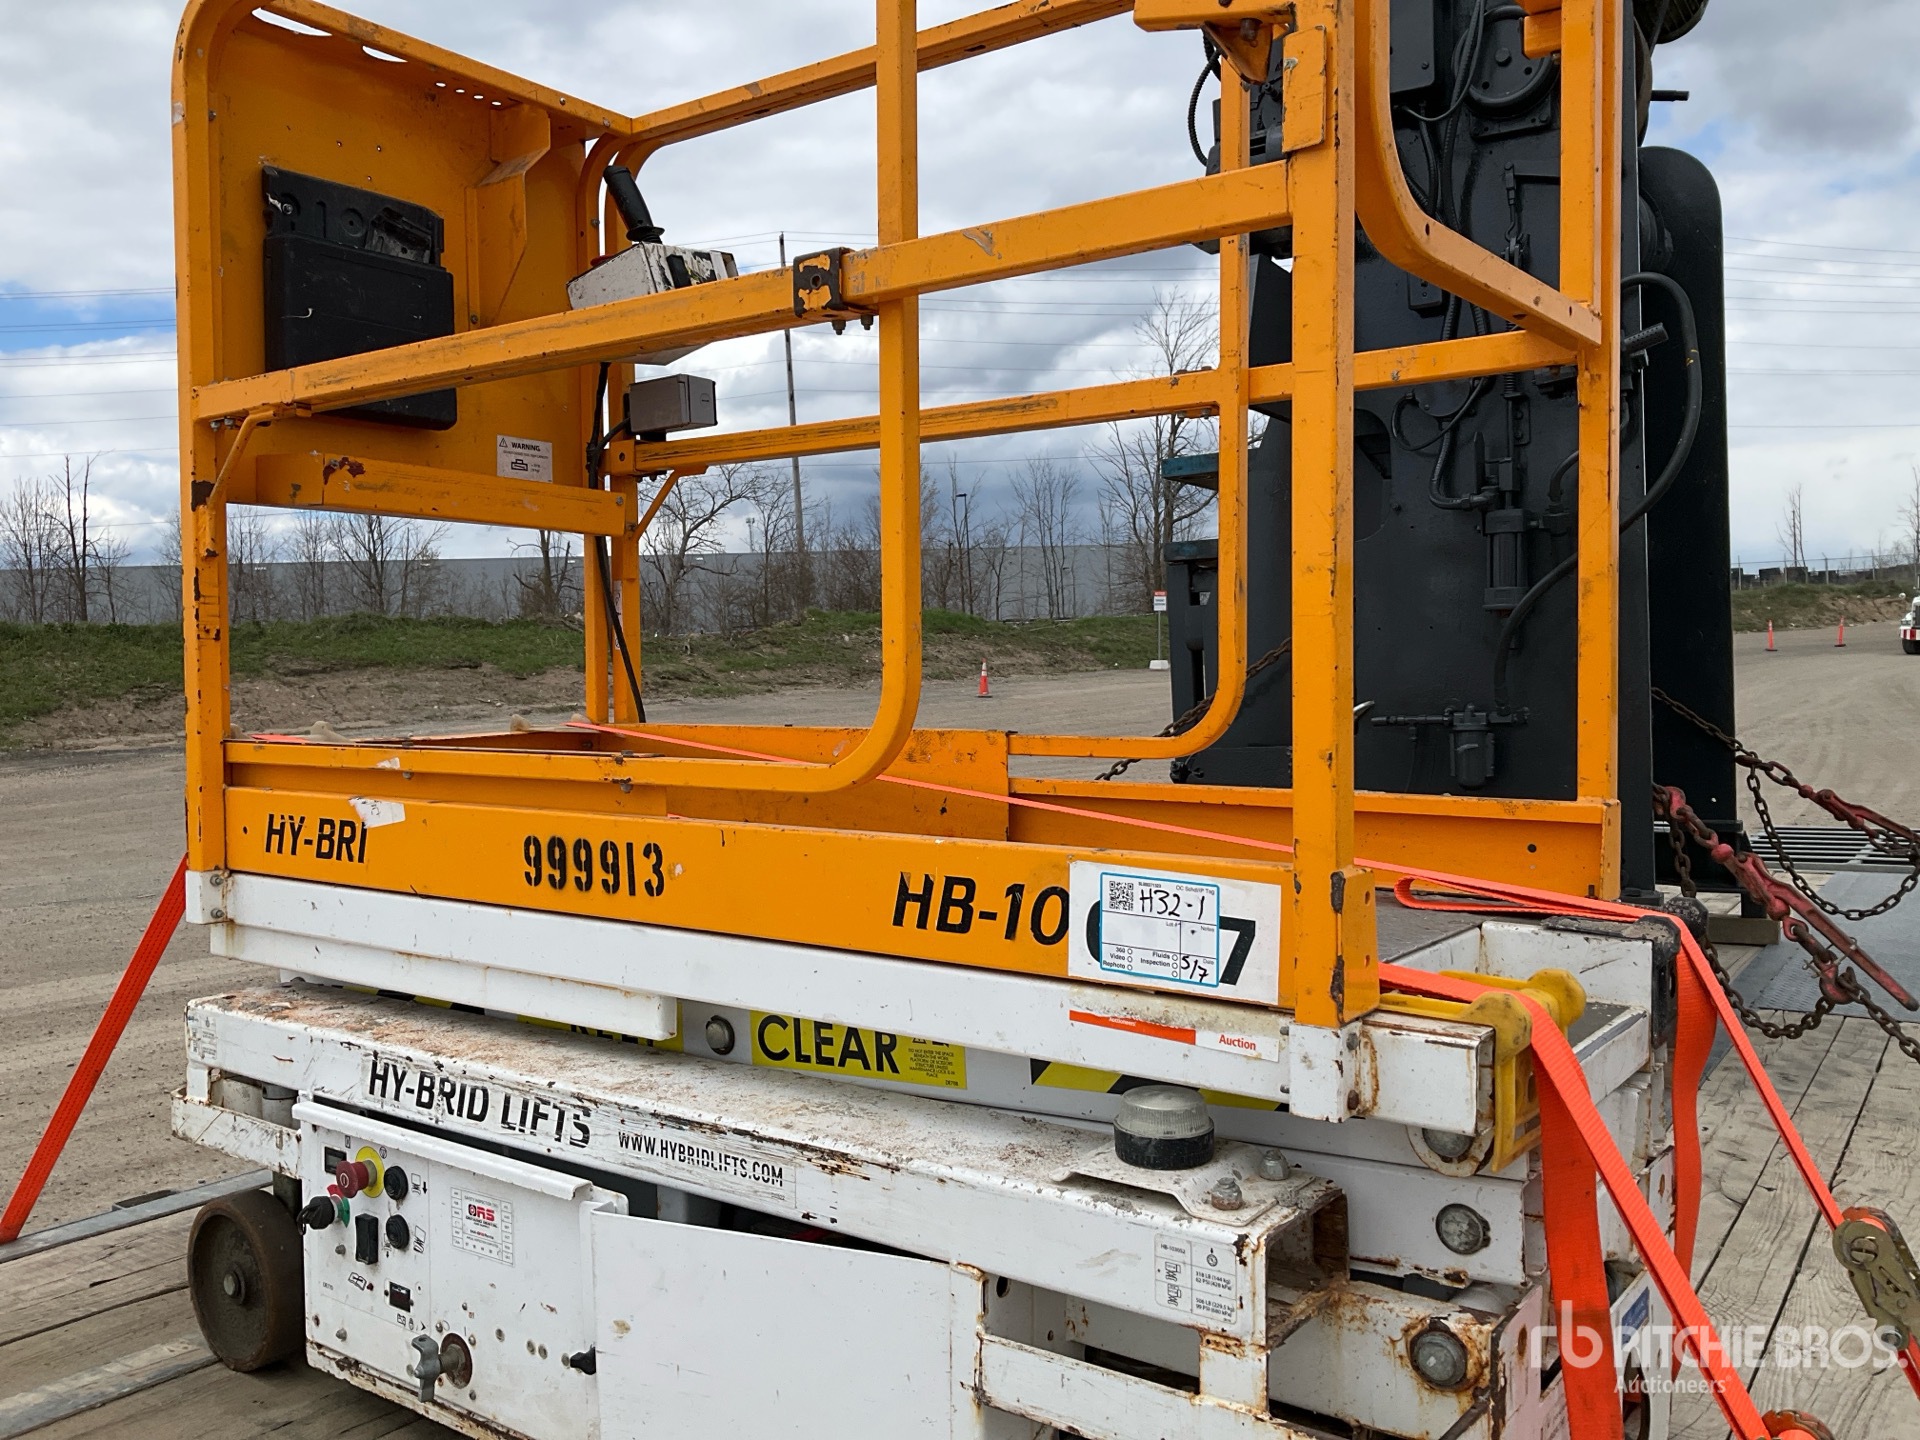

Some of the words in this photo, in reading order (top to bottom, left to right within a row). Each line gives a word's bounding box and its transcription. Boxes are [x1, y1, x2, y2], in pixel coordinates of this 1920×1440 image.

[511, 442, 541, 452] WARNING
[265, 813, 368, 864] HY-BRI
[523, 835, 665, 897] 999913
[1109, 953, 1126, 961] Video
[1140, 958, 1170, 968] Inspection
[1152, 951, 1170, 960] Fluids
[757, 1014, 900, 1075] CLEAR
[1219, 1034, 1257, 1051] Auction
[368, 1059, 490, 1122] HY-BRID
[501, 1093, 591, 1148] LIFTS
[618, 1131, 783, 1187] WWW.HYBRIDLIFTS.COM
